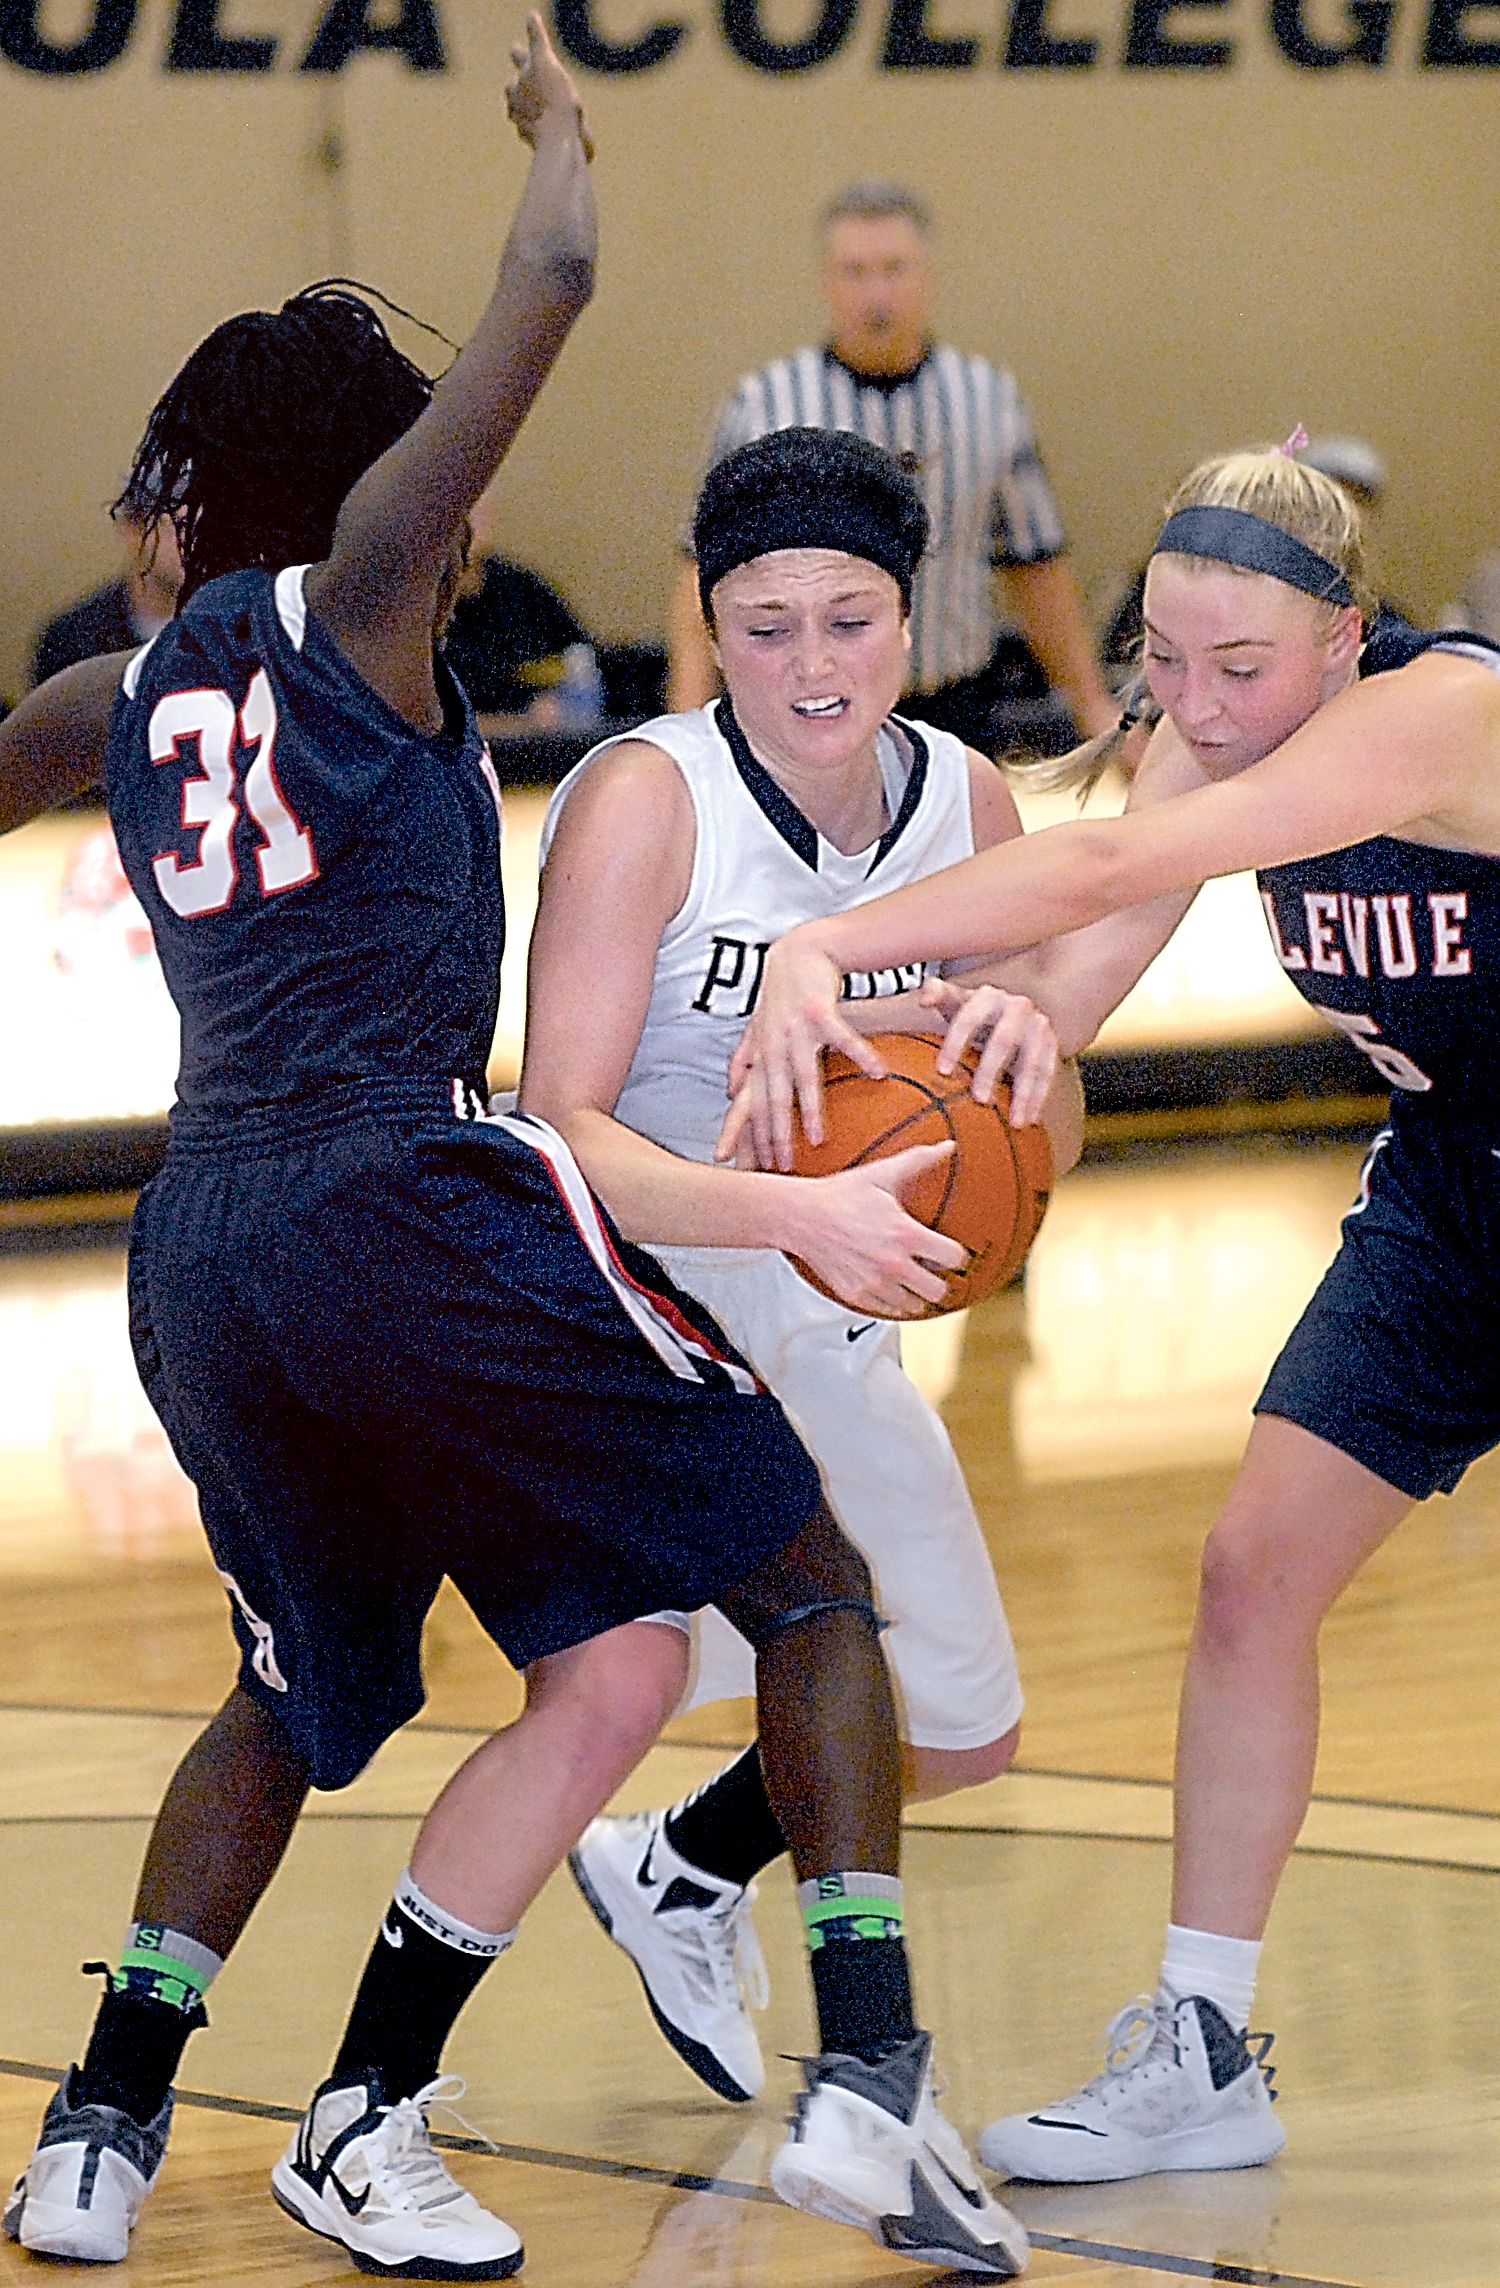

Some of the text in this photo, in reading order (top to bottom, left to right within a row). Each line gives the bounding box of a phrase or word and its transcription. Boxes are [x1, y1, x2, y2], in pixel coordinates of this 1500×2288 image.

[148, 664, 321, 920] 31
[1259, 888, 1473, 979] LEVUE
[401, 1894, 455, 1938] JUST
